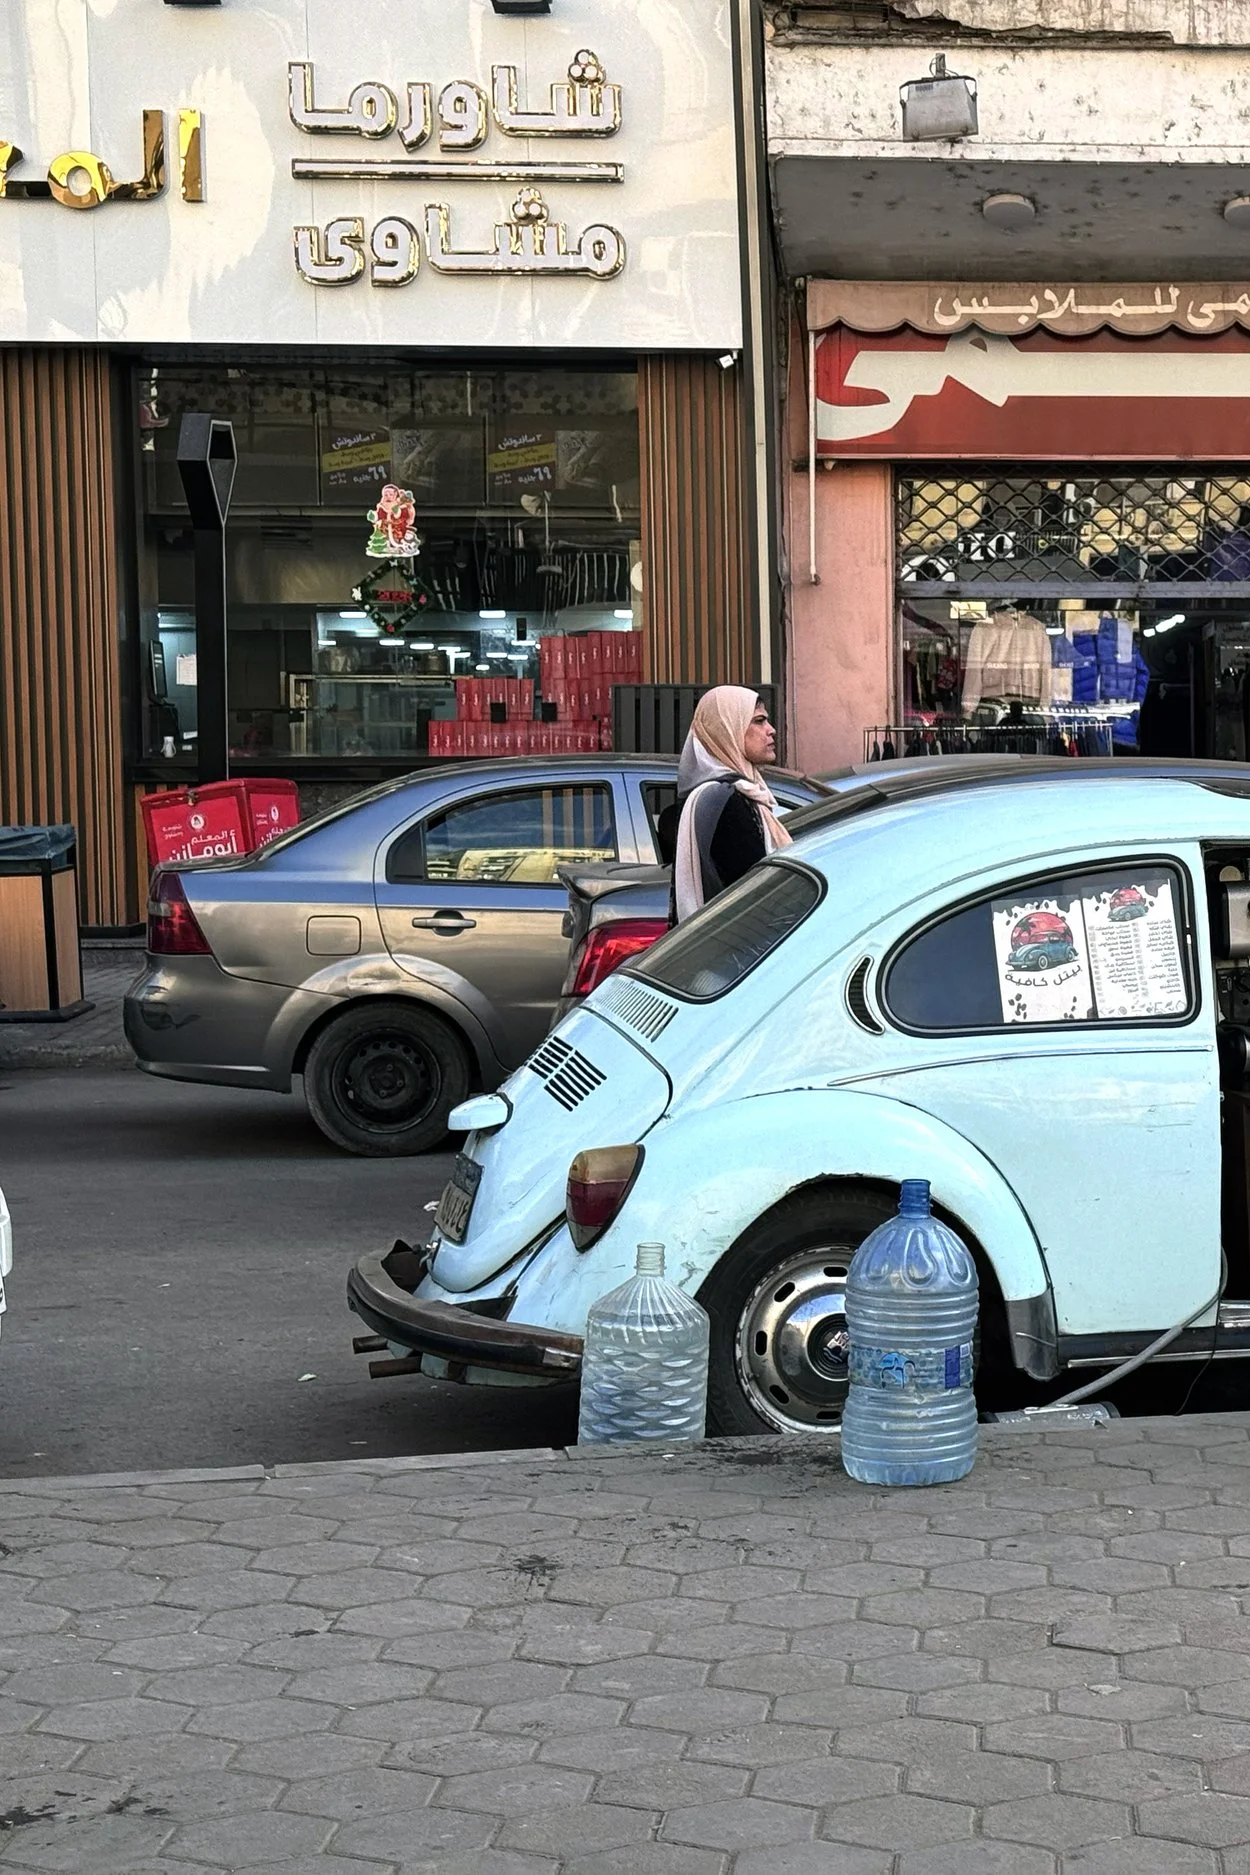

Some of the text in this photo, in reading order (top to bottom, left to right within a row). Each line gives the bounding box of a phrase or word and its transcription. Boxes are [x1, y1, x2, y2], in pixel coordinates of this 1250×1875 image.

[288, 48, 622, 153] شاورما
[293, 187, 626, 287] مشاوى
[933, 284, 1180, 327] للملابس
[1053, 964, 1083, 986] بيتل
